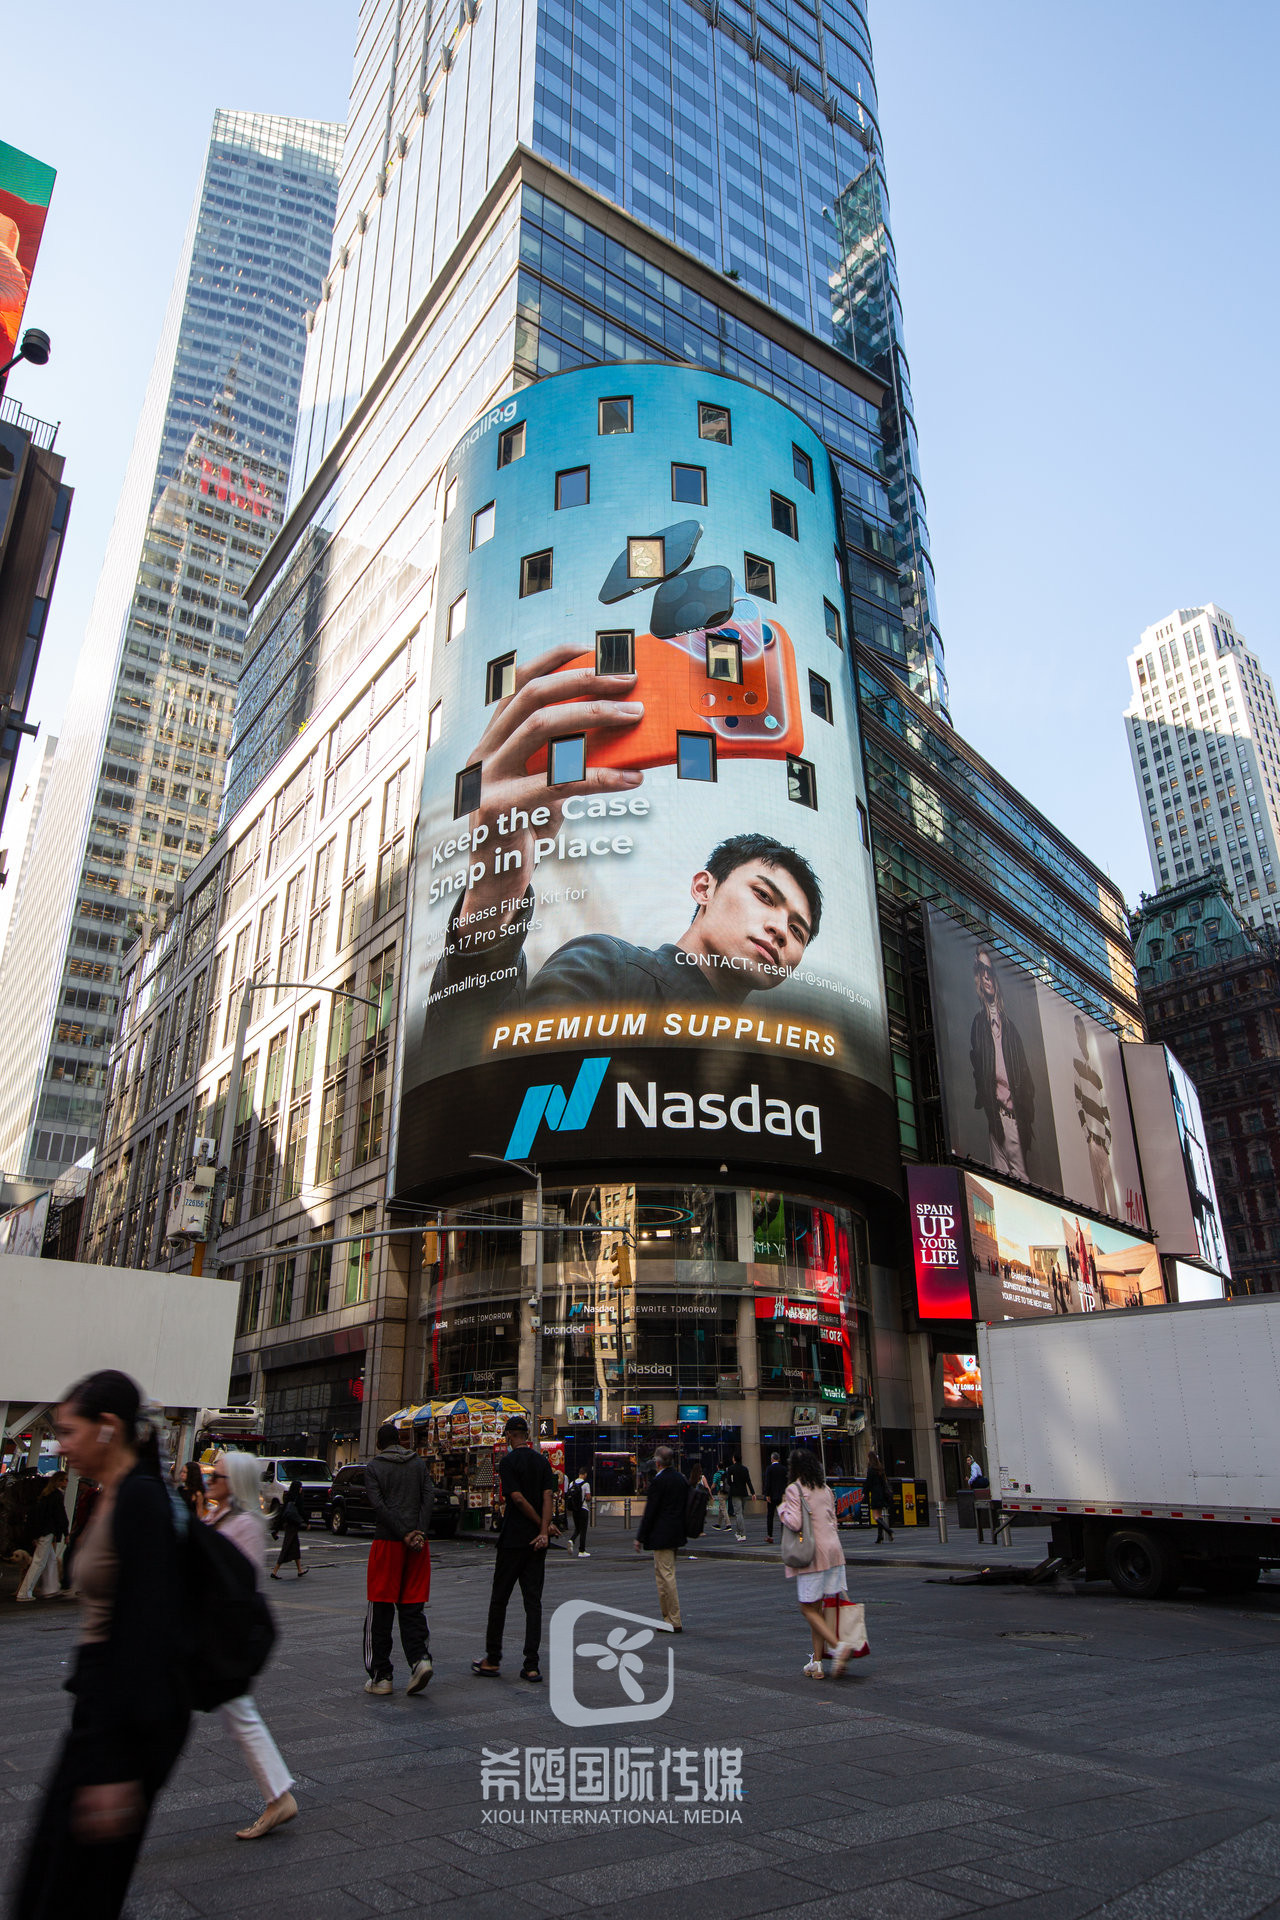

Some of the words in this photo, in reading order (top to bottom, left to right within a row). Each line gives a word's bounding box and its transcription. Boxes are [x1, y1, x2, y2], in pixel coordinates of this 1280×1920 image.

[431, 823, 489, 869] Keep
[497, 806, 550, 836] the
[562, 796, 650, 820] Case
[429, 860, 486, 905] Snap
[494, 847, 522, 875] in
[534, 833, 633, 864] Place
[426, 923, 450, 946] Quick
[452, 906, 497, 931] Release
[501, 896, 536, 914] Filter
[540, 890, 560, 905] Kit
[565, 887, 588, 901] for
[424, 944, 455, 968] iPhone
[458, 935, 471, 951] 17
[475, 930, 496, 945] Pro
[500, 918, 543, 937] Series
[422, 966, 518, 1009] www.smallrig.com
[675, 952, 754, 971] CONTACT:
[757, 961, 872, 1010] reseller@smallrig.com
[492, 1013, 647, 1050] PREMIUM
[663, 1013, 836, 1057] SUPPLIERS
[617, 1081, 822, 1155] Nasdaq
[916, 1203, 953, 1216] SPAIN
[1125, 1187, 1145, 1228] H&M
[917, 1215, 955, 1238] UP
[919, 1237, 957, 1250] YOUR
[920, 1249, 959, 1265] LIFE
[1078, 1280, 1094, 1294] SPAIN
[1079, 1292, 1096, 1313] UP
[477, 1312, 512, 1322] TOMORROW
[583, 1305, 615, 1314] Nasdaq
[630, 1305, 667, 1313] REWRITE
[671, 1305, 718, 1314] TOMORROW
[627, 1363, 673, 1377] Nasdaq
